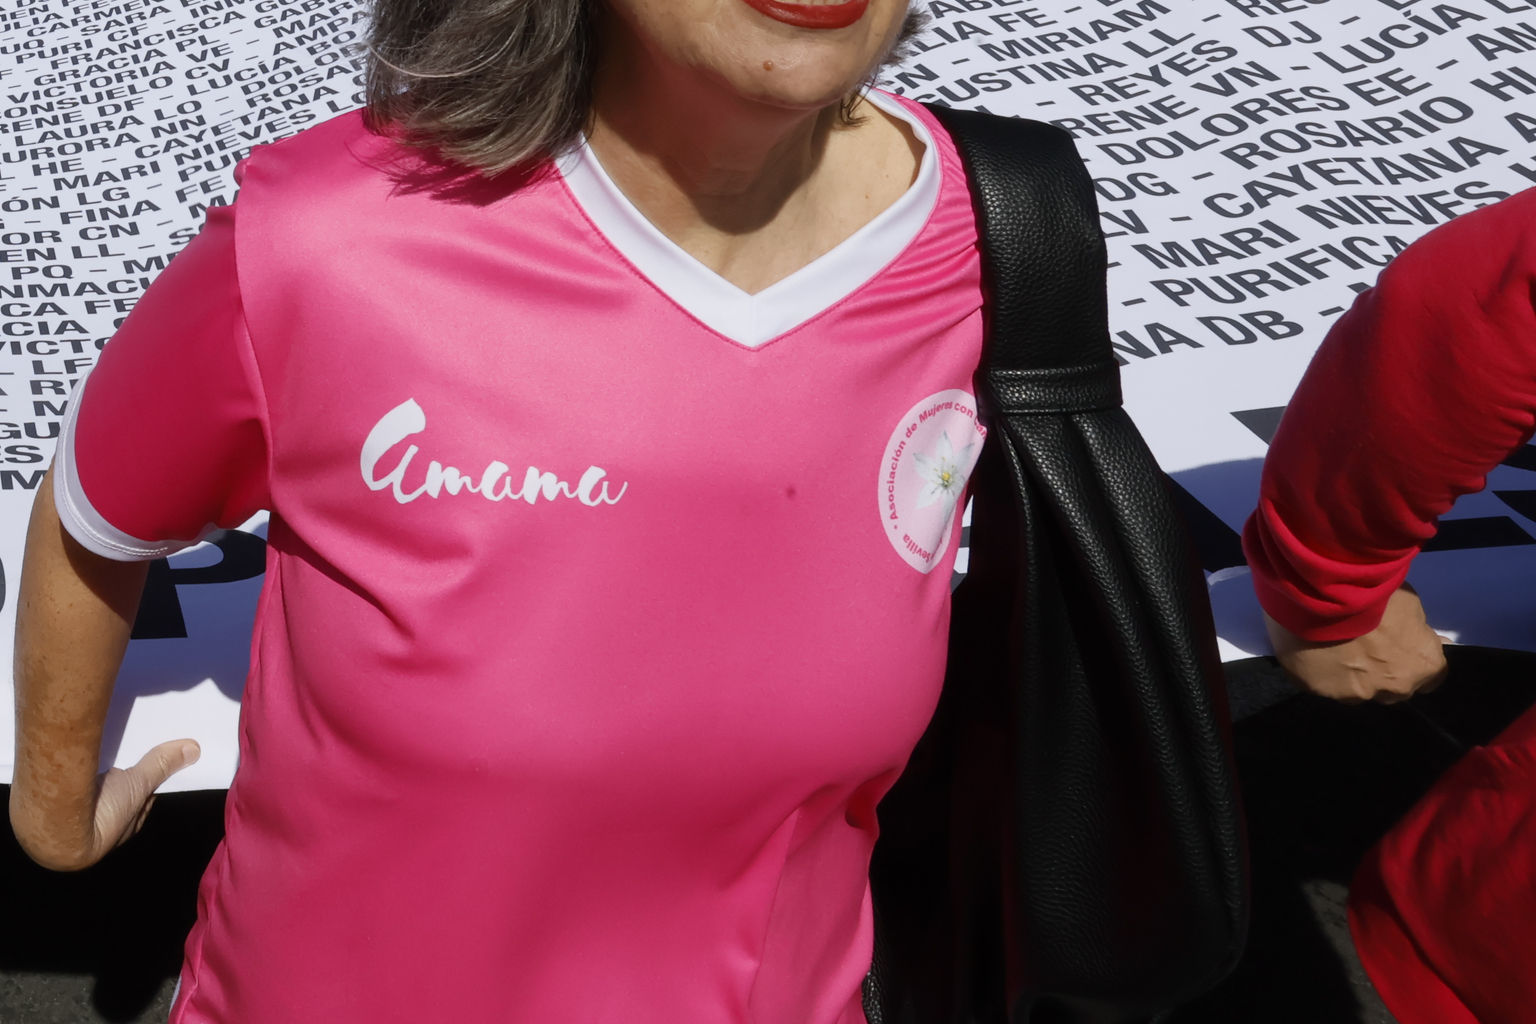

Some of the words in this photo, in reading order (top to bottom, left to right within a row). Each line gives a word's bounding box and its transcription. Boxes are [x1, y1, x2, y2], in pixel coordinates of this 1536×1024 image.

[1067, 39, 1239, 107] REYES
[1241, 20, 1323, 48] DJ
[1190, 60, 1282, 97] VN
[1312, 3, 1489, 74] LUCÍA
[98, 97, 145, 118] DF
[186, 59, 295, 97] LUCÍA
[1095, 86, 1351, 166] DOLORES
[1343, 67, 1433, 107] EE
[14, 115, 141, 147] LAURA
[31, 158, 86, 176] HE
[134, 85, 340, 159] CAYETANA
[53, 160, 162, 192] MARI
[174, 109, 317, 166] NIEVES
[1219, 96, 1475, 170] ROSARIO
[60, 199, 162, 225] FINA
[76, 186, 131, 206] LG
[1203, 136, 1509, 219] CAYETANA
[71, 243, 126, 260] LL
[78, 221, 141, 240] CN
[1131, 219, 1301, 270] MARI
[1296, 180, 1515, 230] NIEVES
[11, 264, 74, 279] PQ
[1195, 310, 1305, 347] DB
[887, 440, 906, 521] Asociación
[905, 423, 918, 439] de
[918, 401, 954, 424] Mujeres
[954, 402, 974, 418] con
